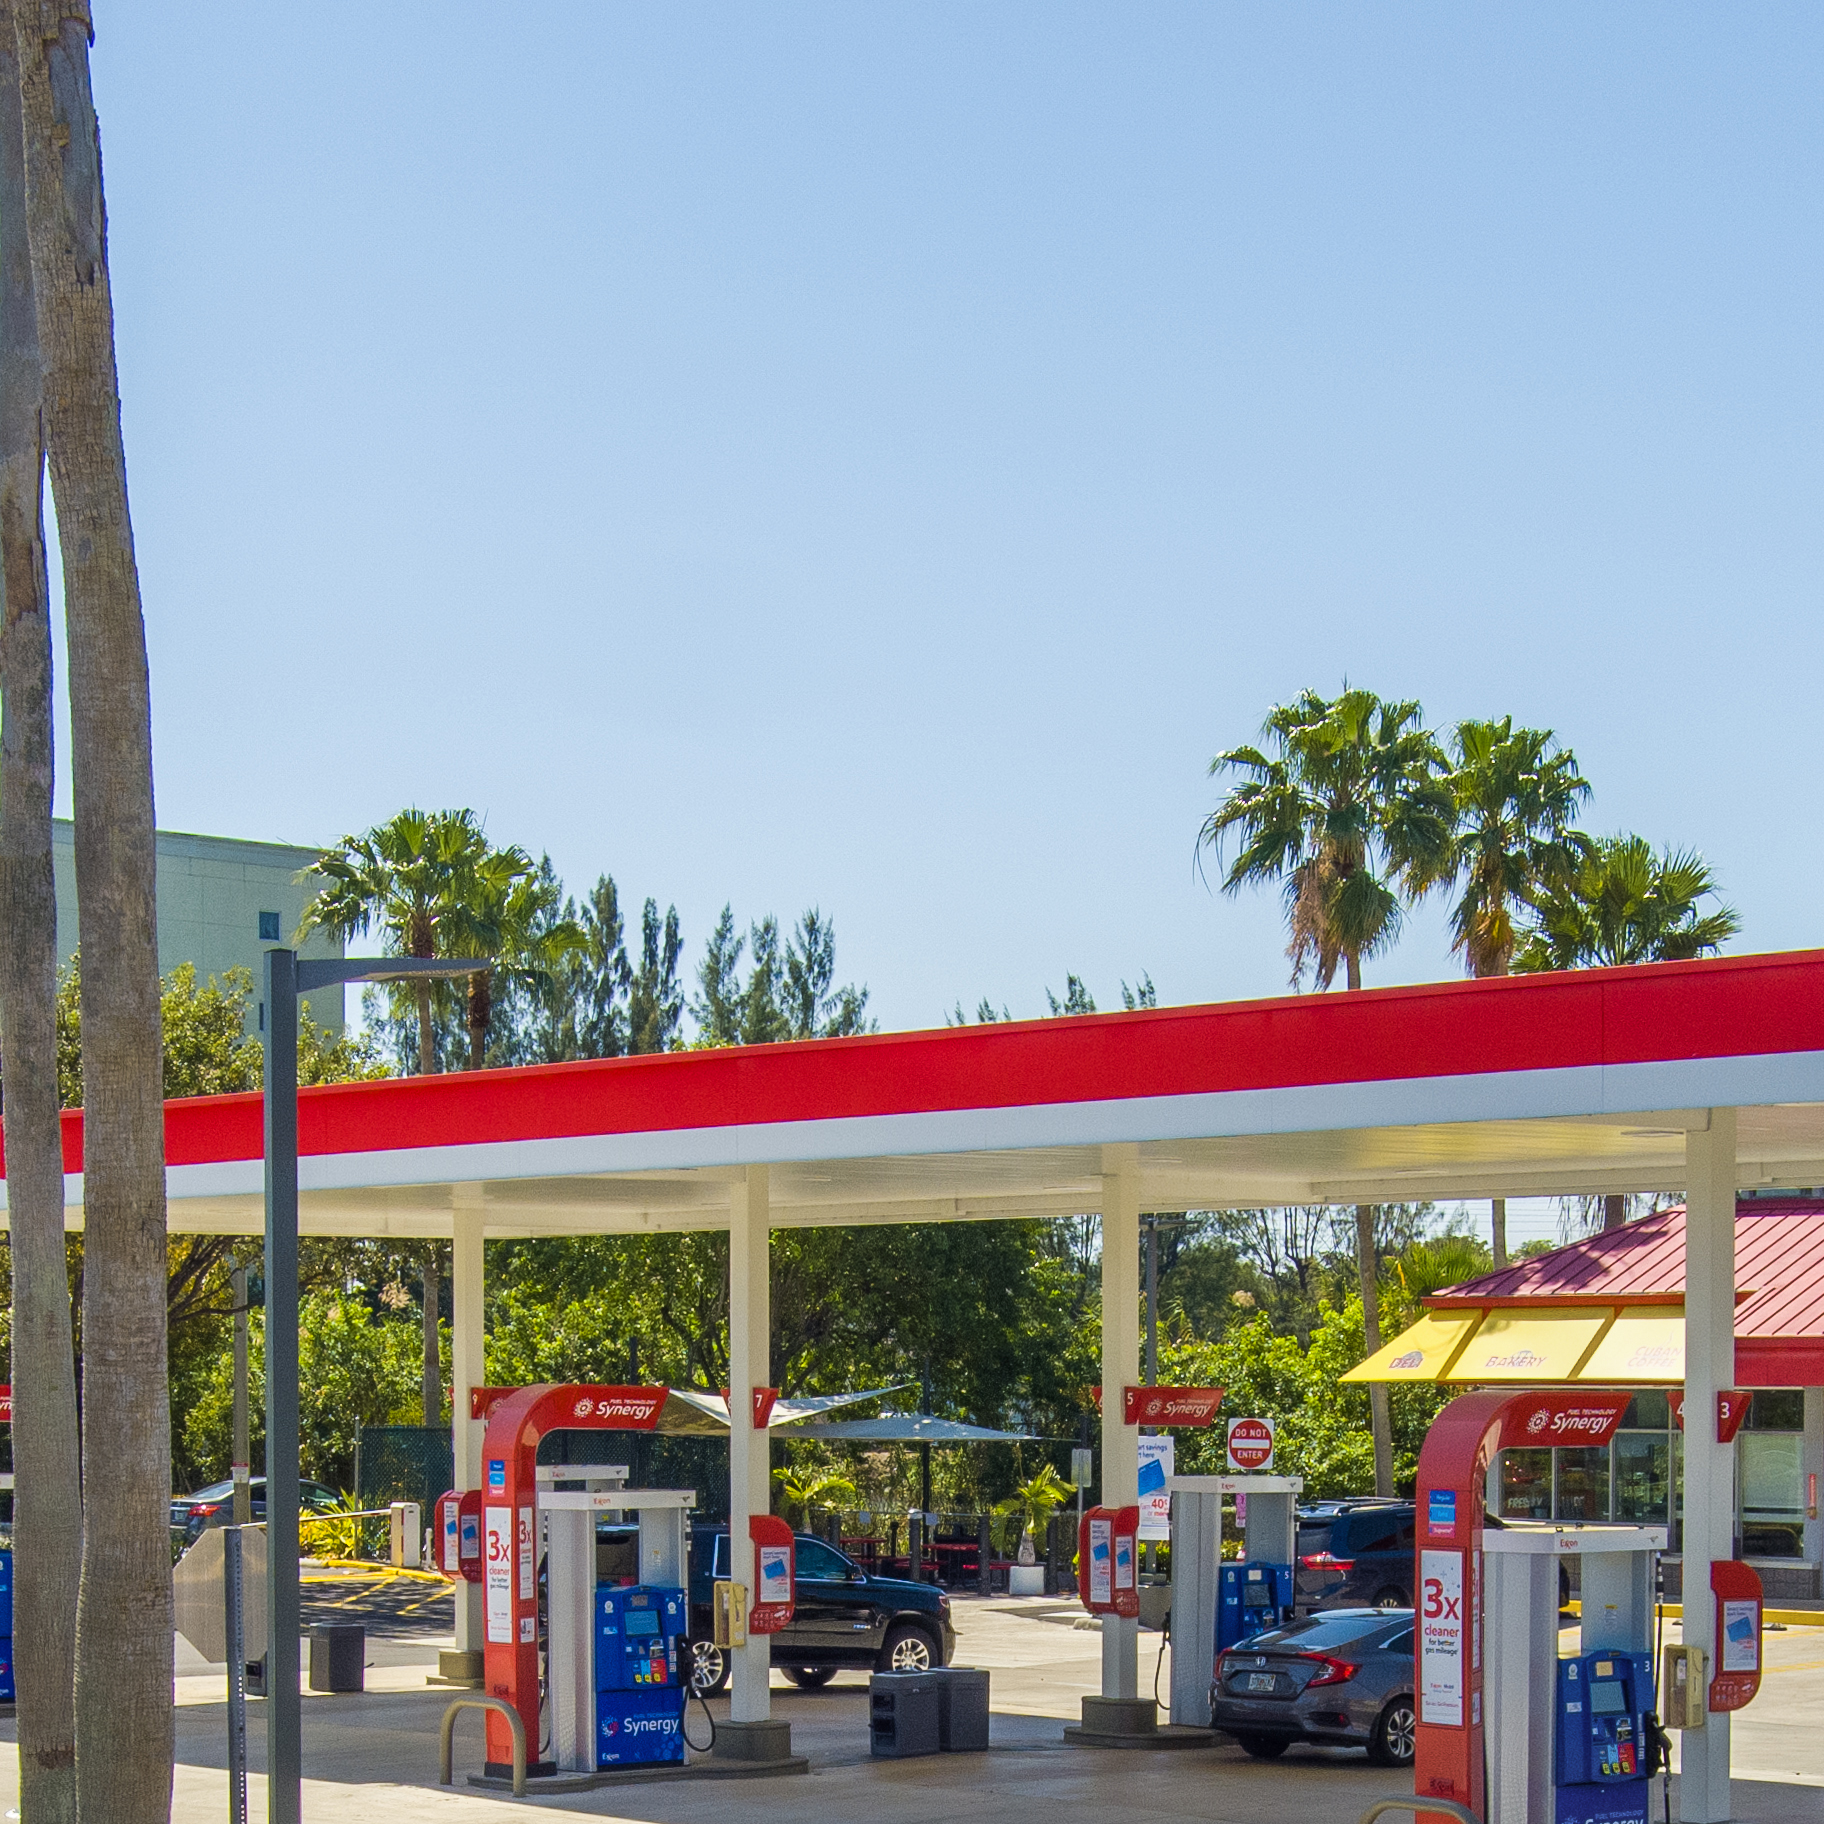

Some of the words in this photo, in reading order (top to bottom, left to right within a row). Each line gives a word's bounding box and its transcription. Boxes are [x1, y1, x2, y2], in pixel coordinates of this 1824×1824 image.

[1635, 1345, 1683, 1357] CUBAN
[1389, 1356, 1423, 1369] DELI
[1485, 1355, 1548, 1368] BAKERY
[1627, 1357, 1677, 1367] COFFEE
[755, 1394, 763, 1408] 7
[1127, 1392, 1134, 1406] 5
[596, 1401, 655, 1420] Synergy
[1163, 1401, 1211, 1418] Synergy
[1720, 1402, 1730, 1418] 3
[1550, 1412, 1614, 1433] Synergy
[1235, 1428, 1247, 1438] DO
[1249, 1428, 1267, 1438] NOT
[1145, 1444, 1168, 1453] savings
[1237, 1450, 1264, 1459] ENTER
[519, 1520, 532, 1545] 3x
[488, 1529, 510, 1563] 3x
[1560, 1538, 1578, 1549] Exxon
[489, 1565, 510, 1576] cleaner
[1284, 1571, 1290, 1580] 5
[677, 1594, 683, 1603] 7
[1424, 1577, 1460, 1621] 3x
[1424, 1624, 1460, 1638] cleaner
[1428, 1637, 1436, 1646] for
[1437, 1638, 1455, 1647] better
[1425, 1647, 1435, 1656] gas
[1435, 1646, 1458, 1657] mileage
[1644, 1660, 1651, 1672] 3
[623, 1717, 679, 1736] Synergy
[602, 1752, 620, 1761] Exxon
